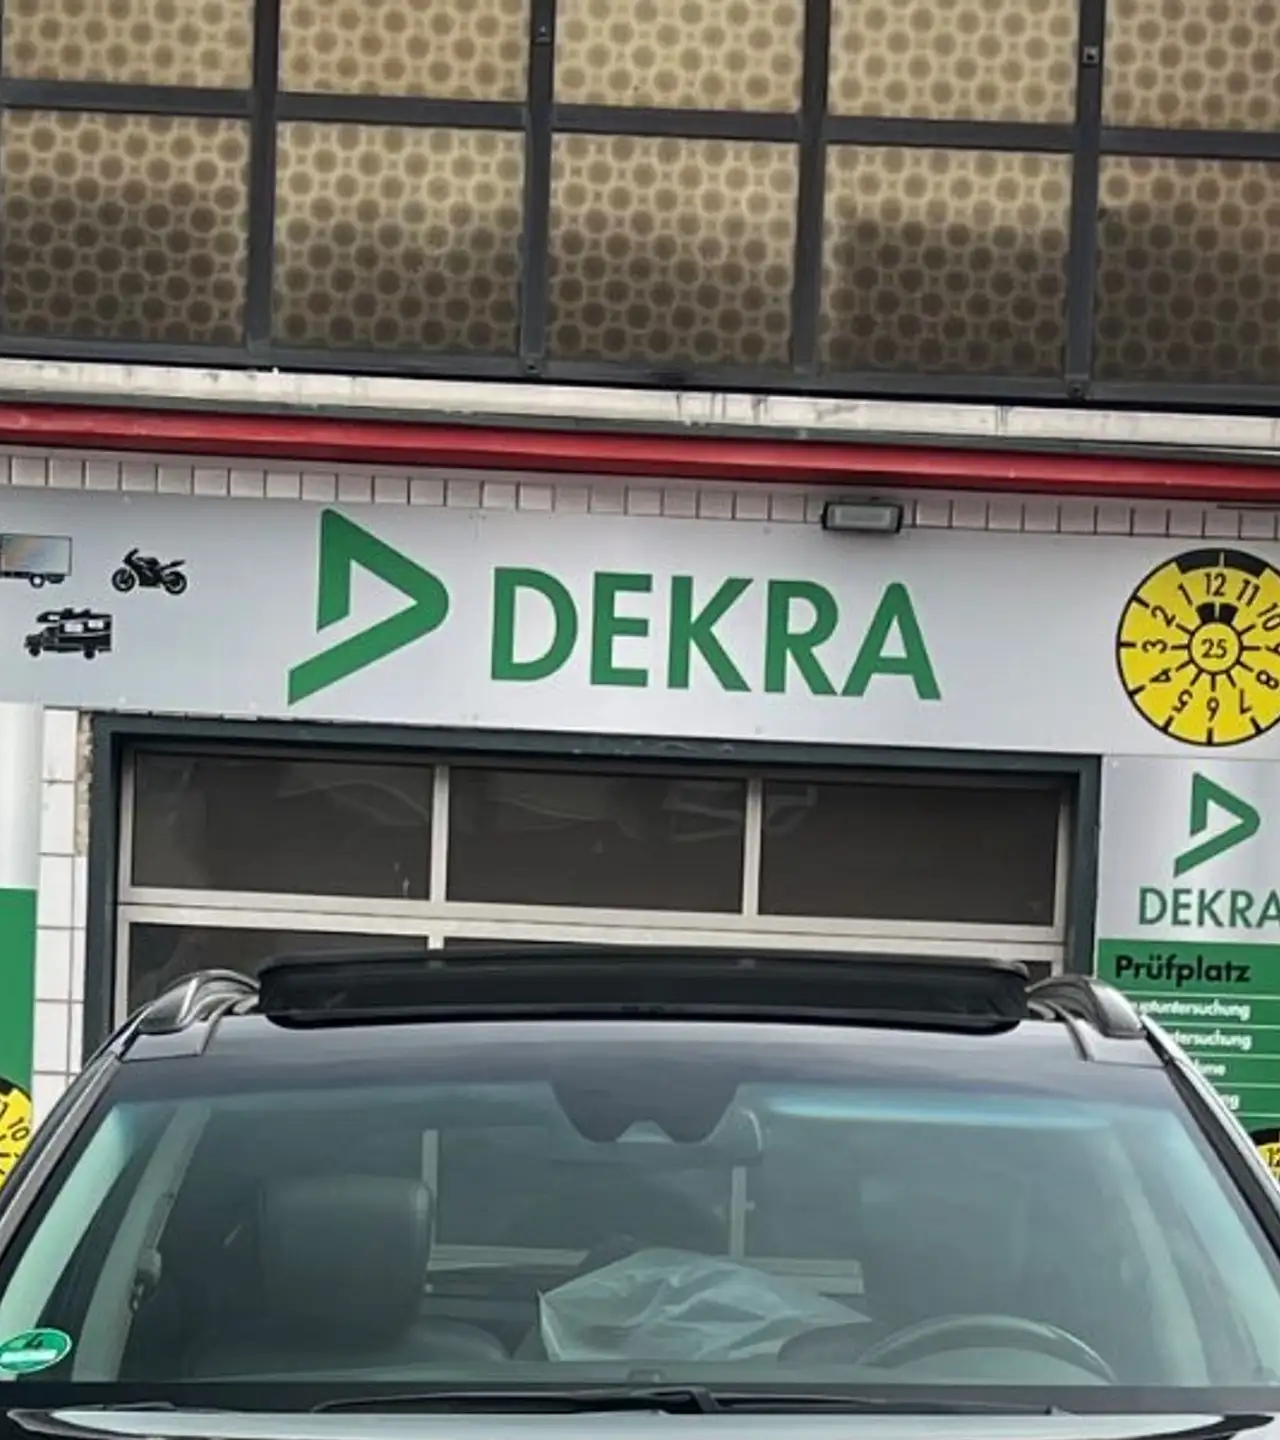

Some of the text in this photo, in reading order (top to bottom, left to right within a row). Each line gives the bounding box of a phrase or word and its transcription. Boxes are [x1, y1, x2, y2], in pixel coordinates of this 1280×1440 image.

[1177, 583, 1193, 606] 1
[1204, 572, 1227, 597] 12
[1236, 578, 1260, 607] 11
[1151, 605, 1177, 628] 2
[491, 566, 942, 700] DEKRA
[1142, 639, 1168, 654] 3
[1200, 639, 1228, 660] 25
[1150, 668, 1173, 684] 4
[1255, 670, 1280, 689] 8
[1172, 689, 1194, 714] 5
[1239, 689, 1253, 715] 7
[1115, 954, 1251, 987] Prüfplatz
[8, 1116, 30, 1141] 10
